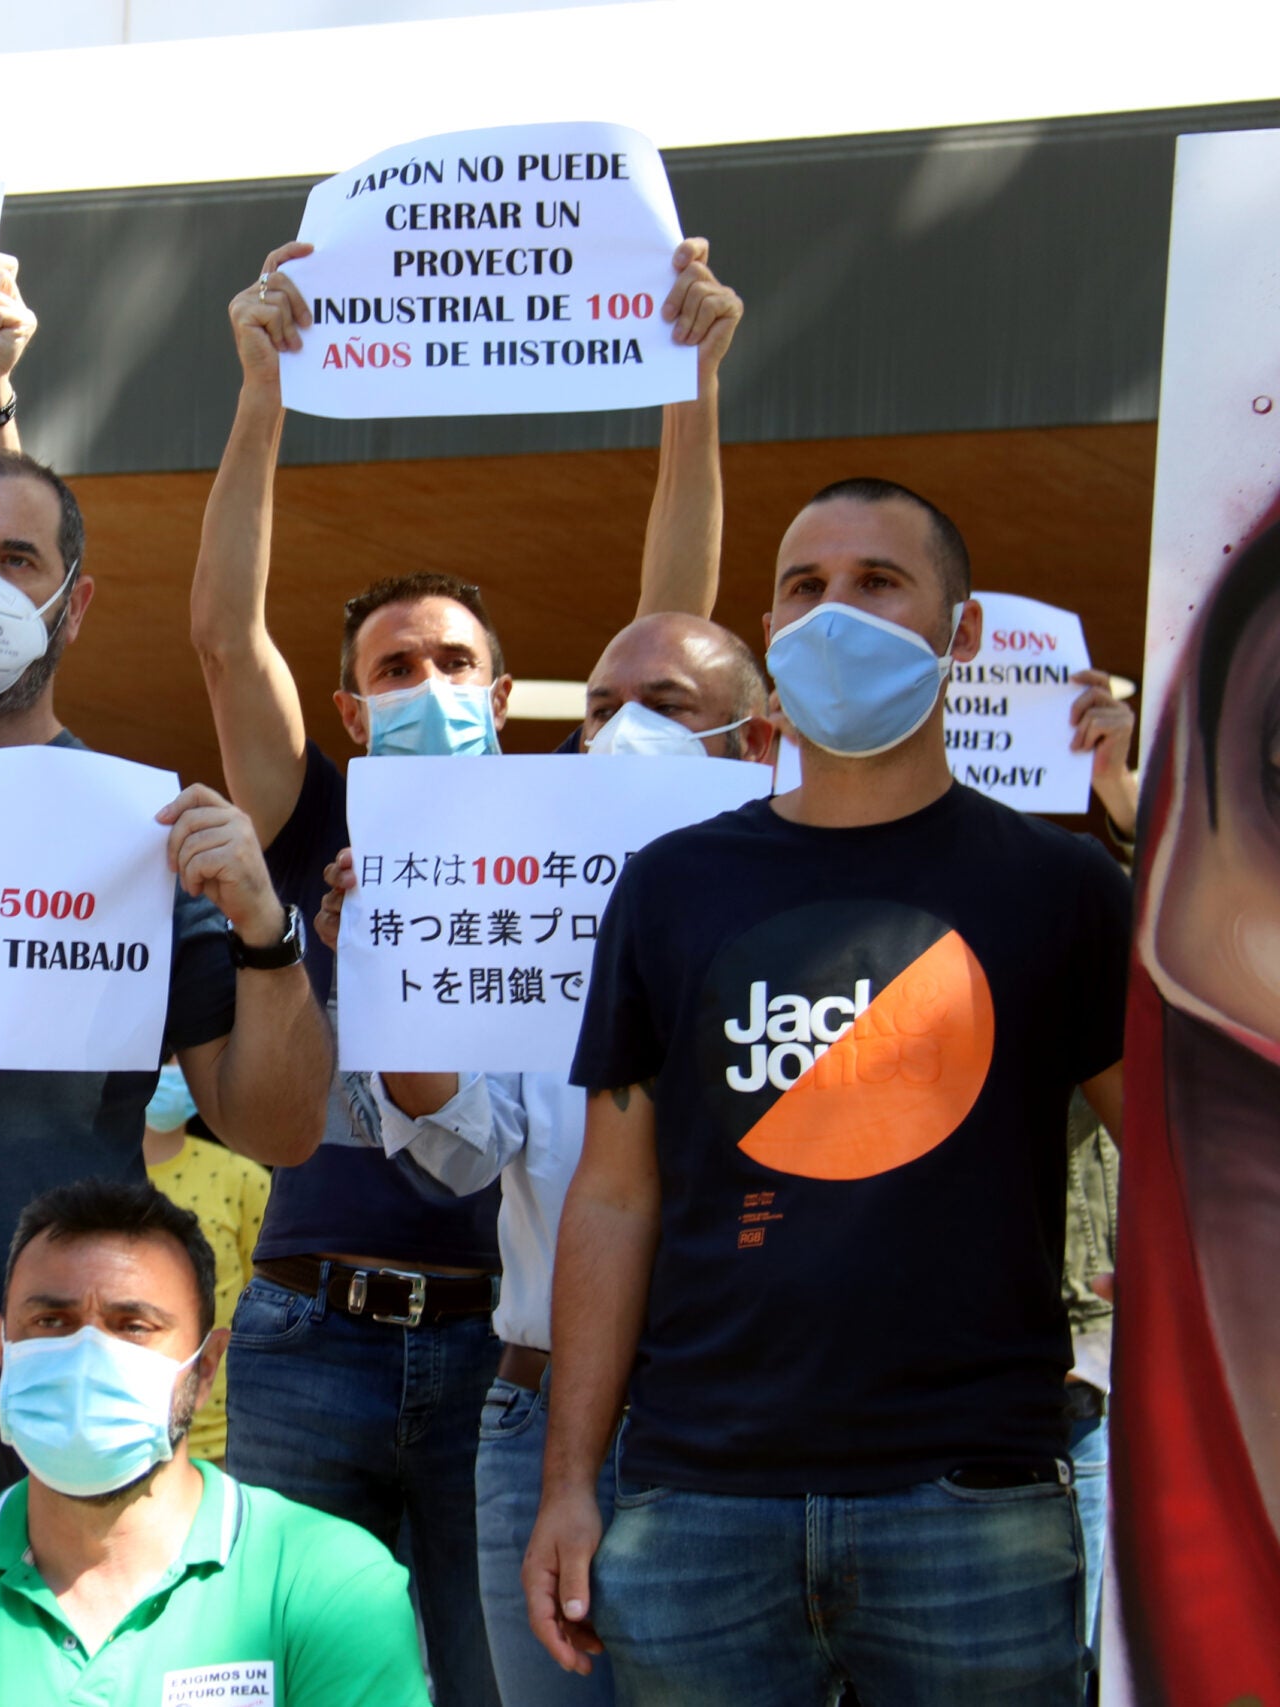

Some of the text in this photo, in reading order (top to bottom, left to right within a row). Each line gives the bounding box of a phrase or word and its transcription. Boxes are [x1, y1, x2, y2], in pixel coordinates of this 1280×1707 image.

[346, 153, 629, 199] JAPÓN NO PUEDE
[385, 200, 581, 231] CERRAR UN
[393, 247, 573, 277] PROYECTO
[313, 292, 654, 324] INDUSTRIAL DE 100
[322, 336, 644, 369] AÑOS DE HISTORIA
[992, 630, 1058, 655] AÑOS
[949, 664, 1070, 684] INDUSTRI
[944, 697, 1008, 716] PROY
[945, 729, 1012, 751] CERR
[964, 764, 1047, 791] JAPÓN
[360, 851, 639, 889] 日本は100年の
[370, 907, 598, 947] 持つ産業プロ
[2, 938, 149, 973] TRABAJO
[400, 966, 586, 1005] トを閉鎖で
[168, 1685, 270, 1702] FUTURO REAL
[171, 1669, 267, 1688] EXIGIMOS UN
